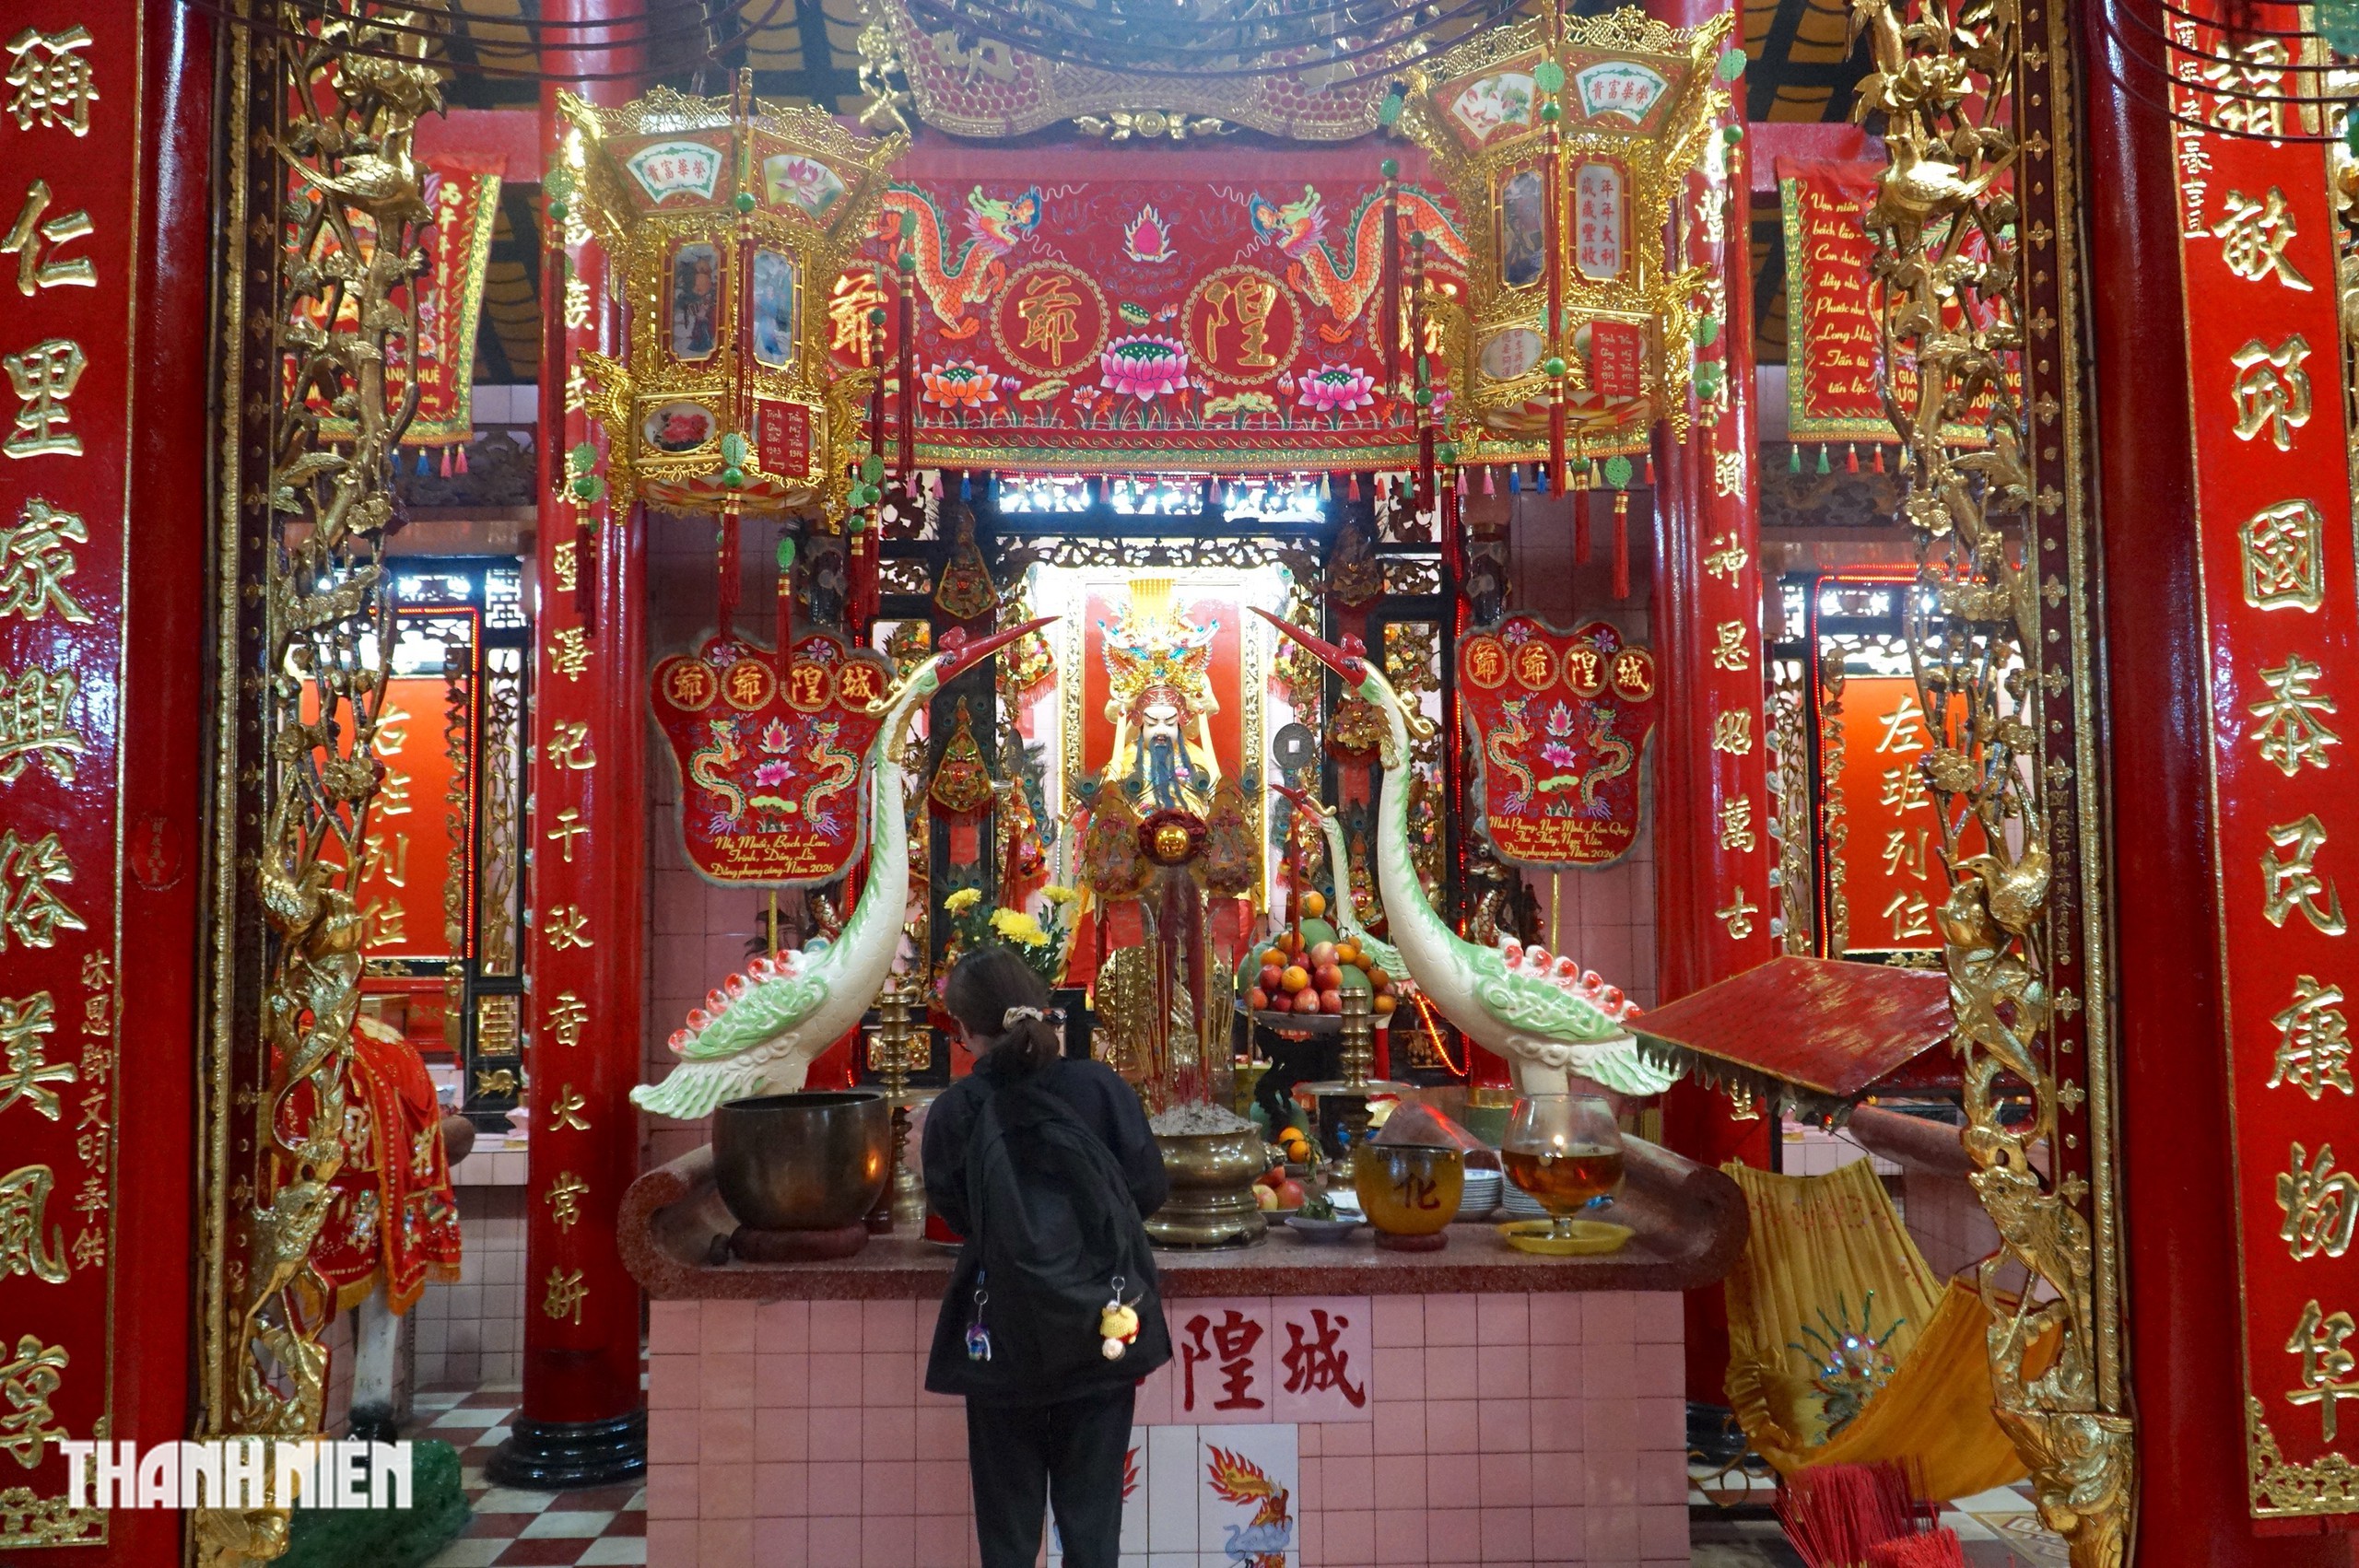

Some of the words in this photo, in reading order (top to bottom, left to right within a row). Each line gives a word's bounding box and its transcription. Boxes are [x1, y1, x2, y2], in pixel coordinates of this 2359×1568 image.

[1815, 243, 1838, 261] Con
[1816, 322, 1850, 344] Long
[1875, 693, 1933, 942] 左班列位
[773, 835, 801, 849] Bạch
[1514, 831, 1531, 843] Thu
[810, 864, 835, 872] 2026
[1393, 1173, 1441, 1211] 化
[1180, 1308, 1367, 1412] 城隍
